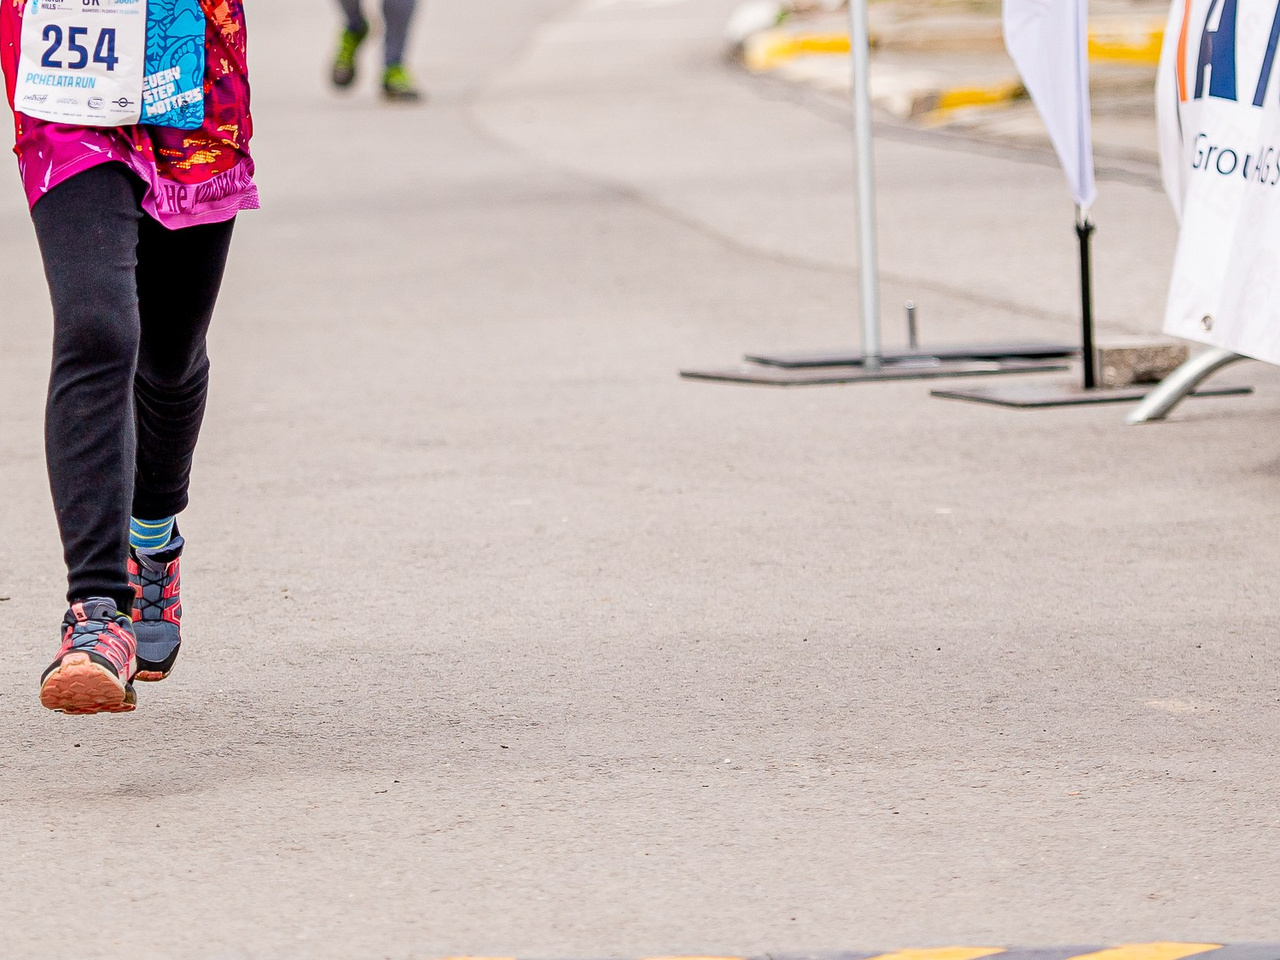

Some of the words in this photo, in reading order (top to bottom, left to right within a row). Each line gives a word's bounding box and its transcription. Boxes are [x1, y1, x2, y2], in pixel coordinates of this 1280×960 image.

[40, 24, 119, 71] 254
[25, 72, 74, 87] PCHELATA
[75, 76, 96, 88] RUN
[143, 82, 175, 104] STEP
